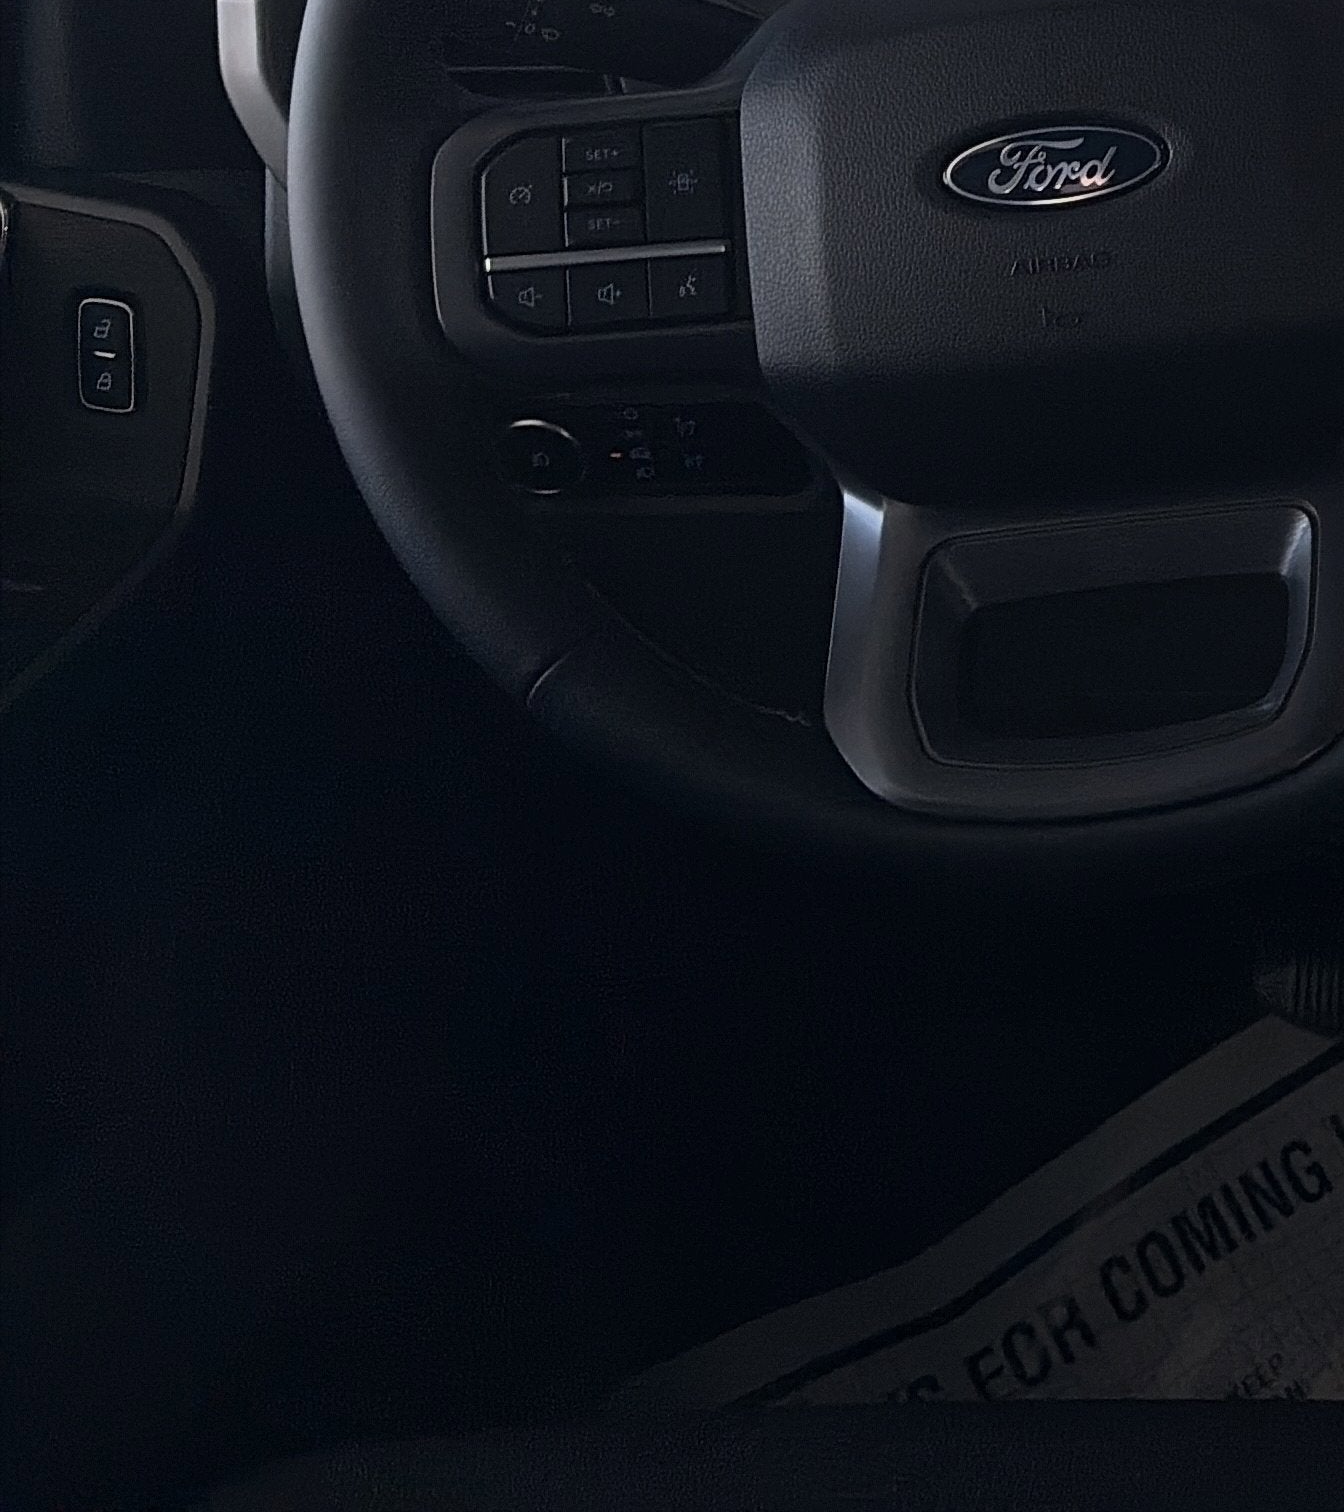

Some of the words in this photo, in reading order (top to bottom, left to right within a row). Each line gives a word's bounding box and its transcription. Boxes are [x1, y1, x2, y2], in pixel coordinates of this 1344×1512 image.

[987, 137, 1118, 195] Ford
[965, 1296, 1097, 1402] FOR
[1098, 1143, 1335, 1323] COMING
